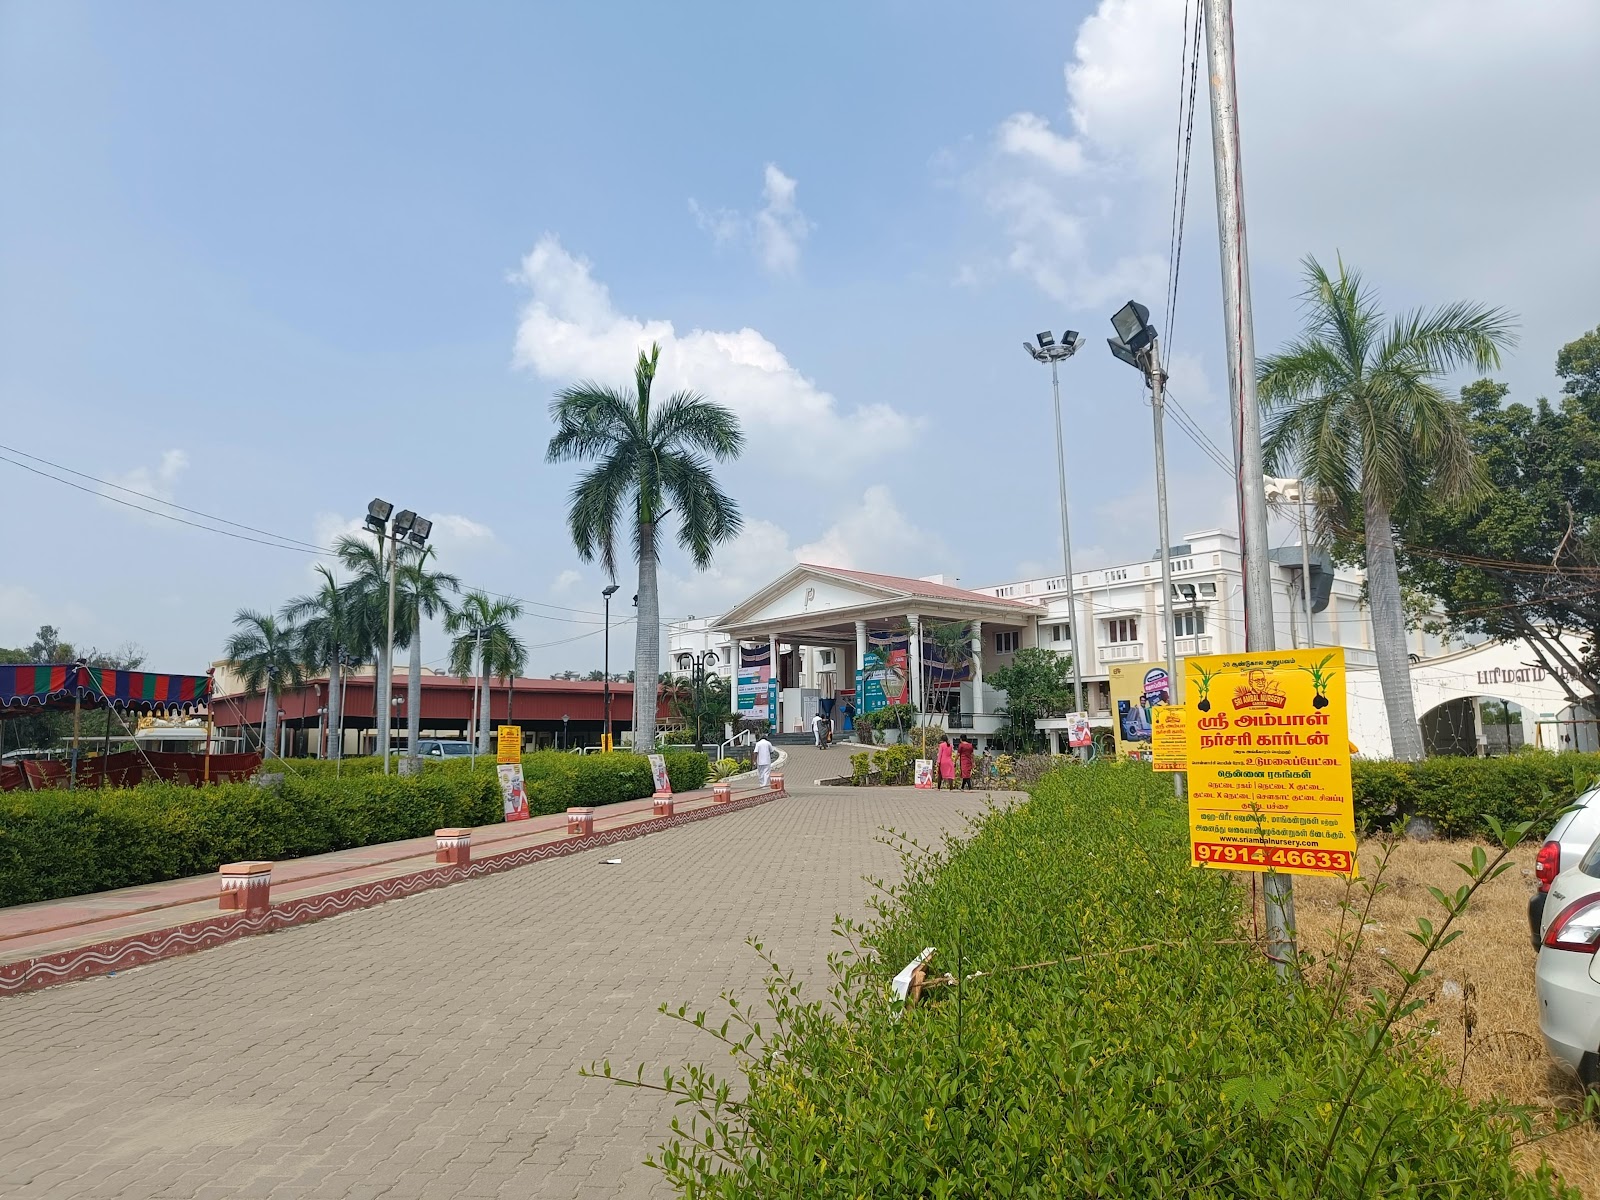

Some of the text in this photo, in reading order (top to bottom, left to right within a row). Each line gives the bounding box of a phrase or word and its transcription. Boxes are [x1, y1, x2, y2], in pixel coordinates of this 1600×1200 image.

[1265, 657, 1296, 667] அனுபவம்
[1234, 694, 1285, 706] SRI AMBAL NURSERY
[1197, 711, 1330, 730] ஸ்ரீ அம்பாள்
[1200, 731, 1252, 750] நர்சரி
[1256, 731, 1330, 746] கார்டன்
[1246, 756, 1342, 766] உடுமலைப்பேட்டை
[1217, 769, 1311, 779] தென்னை ரகங்கள்
[1208, 781, 1234, 789] நெட்டை
[1235, 781, 1252, 789] ரகம்
[1257, 782, 1286, 790] நெட்டை
[1193, 791, 1215, 799] குட்டை
[1223, 792, 1251, 800] நெட்டை
[1318, 794, 1344, 803] சிவப்பு
[1266, 802, 1289, 810] பச்சை
[1271, 816, 1319, 826] மாங்கன்றுகள்
[1220, 836, 1319, 847] www.sriambalnursery.com
[1197, 845, 1348, 869] 97914 46633
